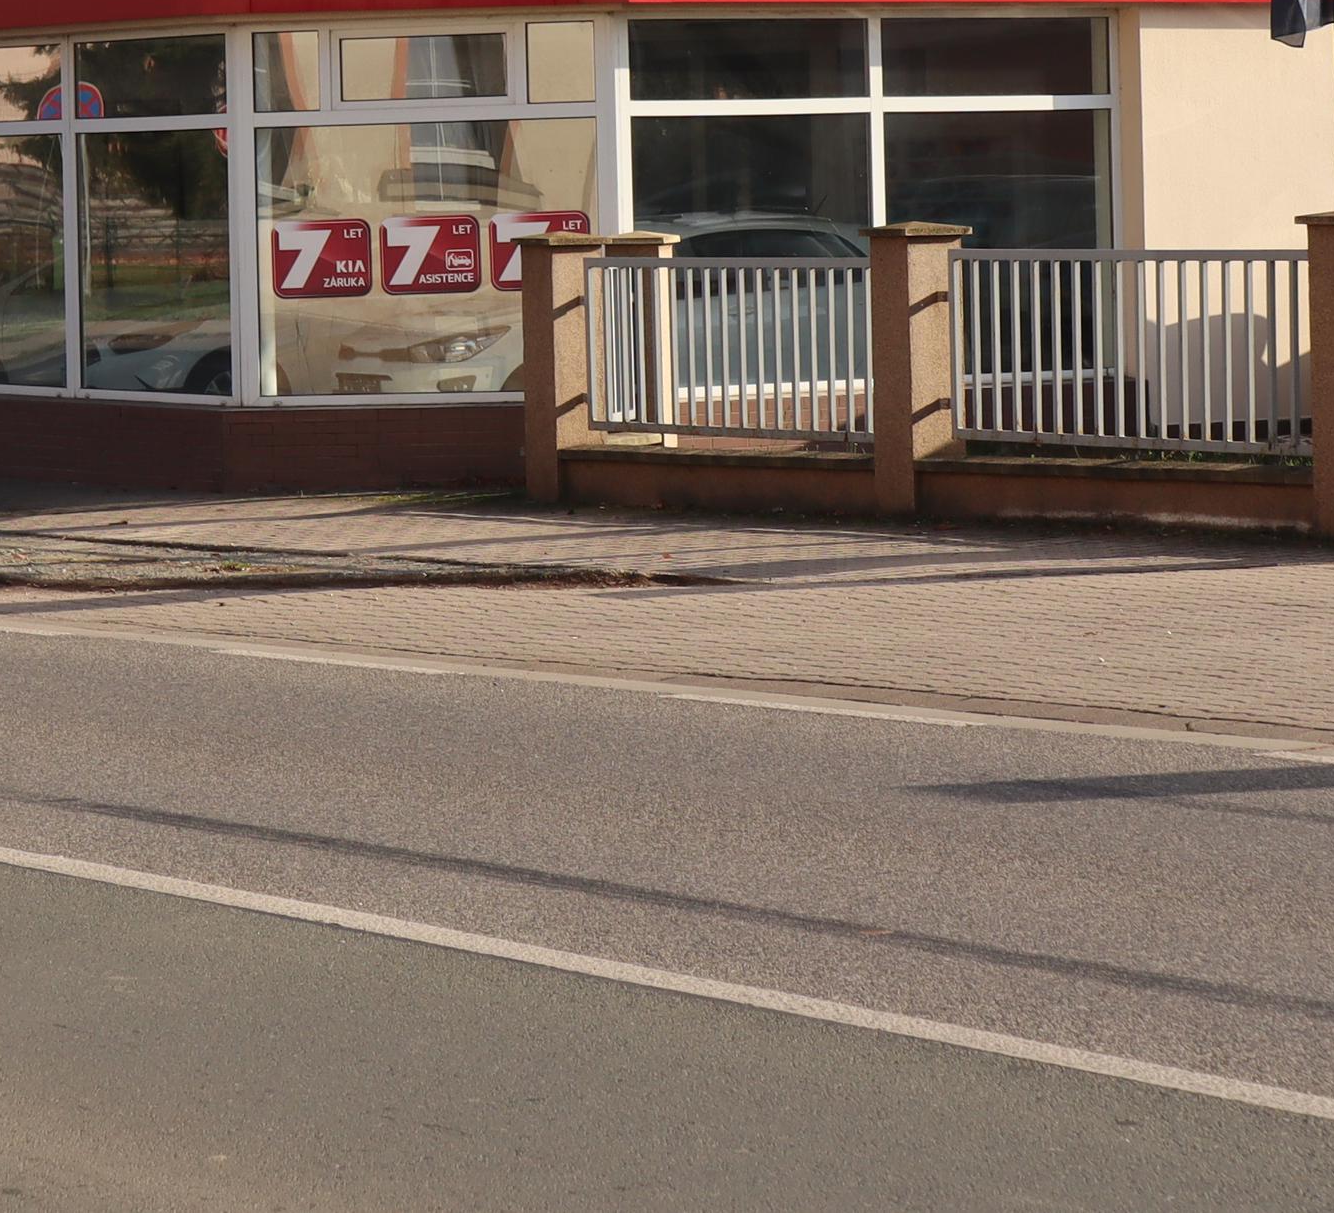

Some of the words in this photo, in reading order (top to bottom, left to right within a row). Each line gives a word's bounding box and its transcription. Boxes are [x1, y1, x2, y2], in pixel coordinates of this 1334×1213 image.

[562, 219, 583, 230] LET
[278, 229, 332, 290] 7
[343, 228, 364, 240] LET
[387, 225, 441, 287] 7
[452, 224, 472, 236] LET
[335, 259, 366, 274] KIA
[323, 274, 366, 289] ZÁRUKA
[418, 272, 475, 285] ASISTENCE
